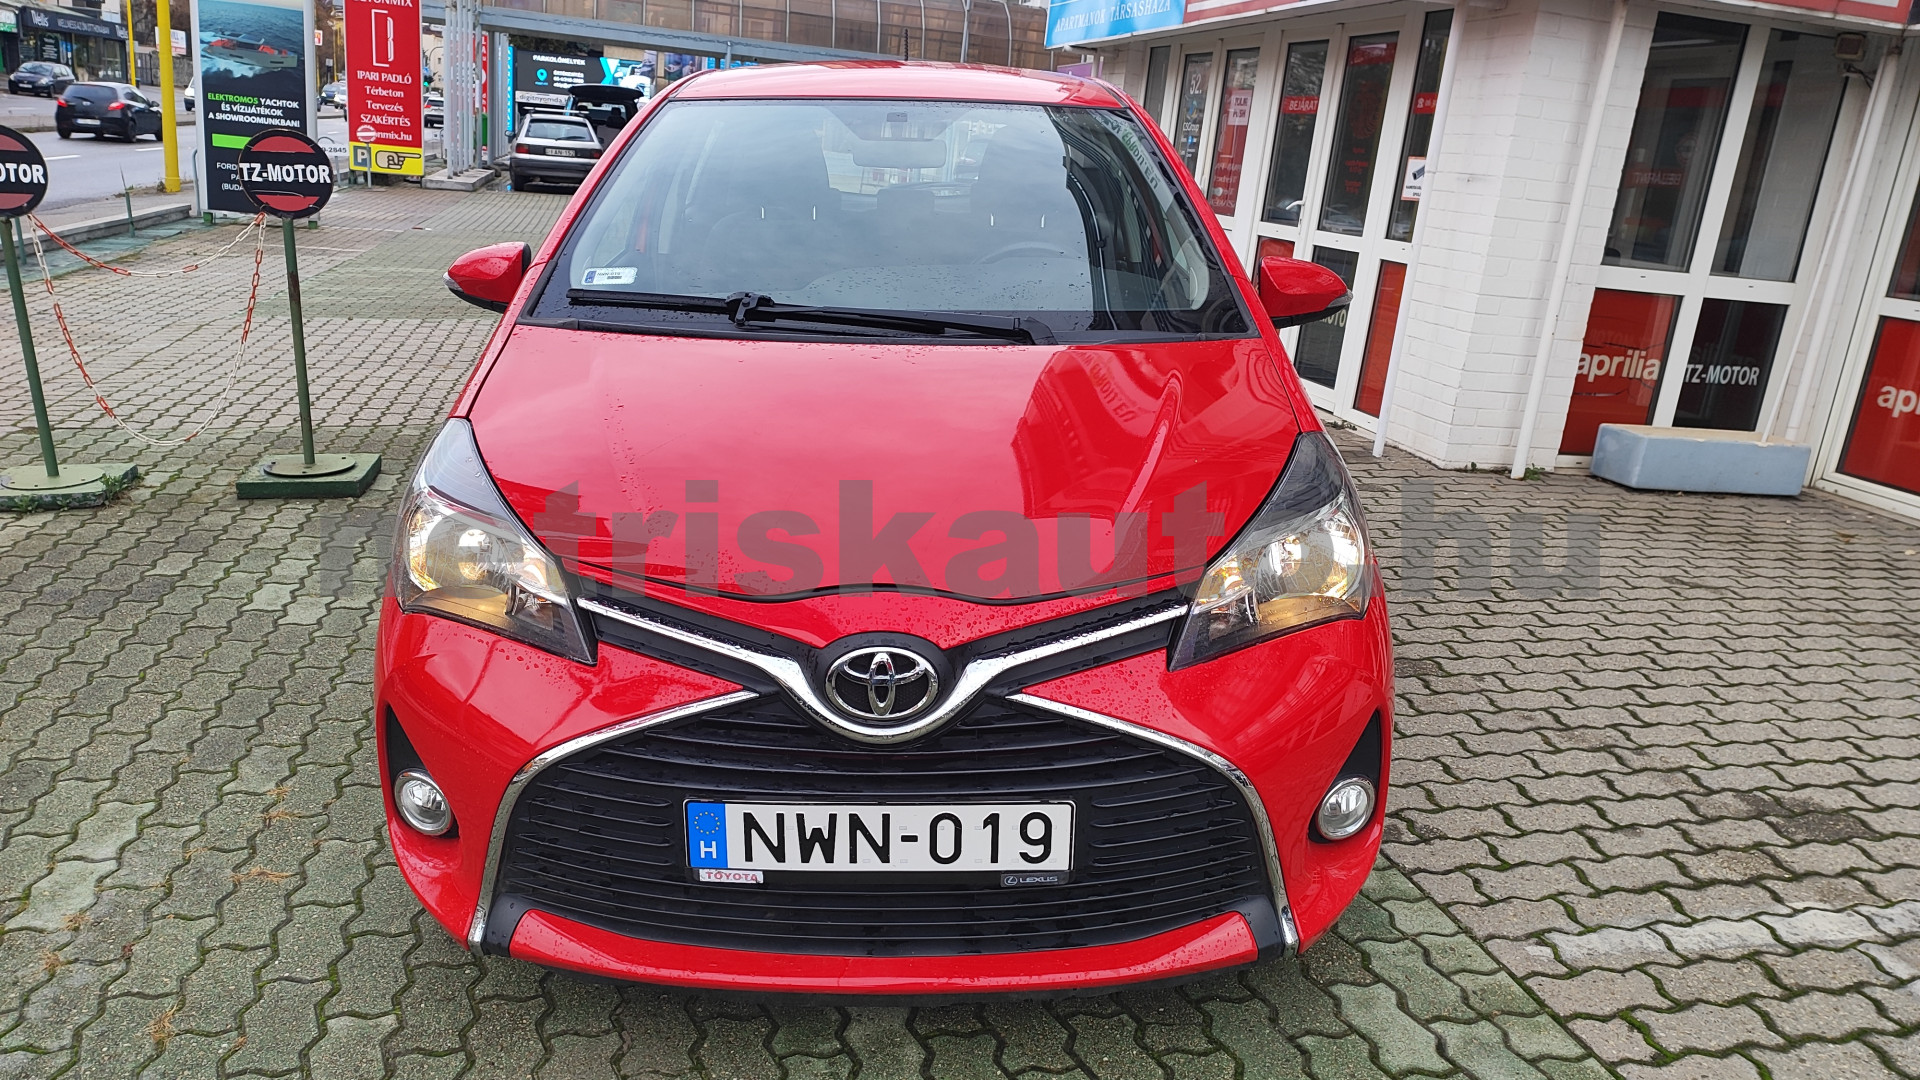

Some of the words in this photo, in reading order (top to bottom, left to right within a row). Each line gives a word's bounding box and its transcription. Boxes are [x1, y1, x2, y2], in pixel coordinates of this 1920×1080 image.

[1055, 9, 1106, 33] APARTMANOK
[357, 70, 379, 80] IPARI
[381, 73, 412, 84] PADLÓ
[364, 86, 404, 98] Térbeton
[207, 93, 259, 104] ELEKTROMOS
[259, 97, 300, 109] YACHTOK
[221, 102, 231, 111] ÉS
[366, 100, 404, 112] Tervezés
[1289, 97, 1318, 112] BEJÁRAT
[215, 113, 300, 128] SHOWROOMUNKBAN!
[360, 113, 411, 127] SZAKÉRTÉS
[239, 162, 331, 184] TZ-MOTOR
[1576, 349, 1661, 383] aprilia
[1685, 363, 1760, 387] TZ-MOTOR
[742, 811, 1053, 865] NWN-019
[700, 840, 717, 859] H
[705, 871, 758, 882] TOYOTA
